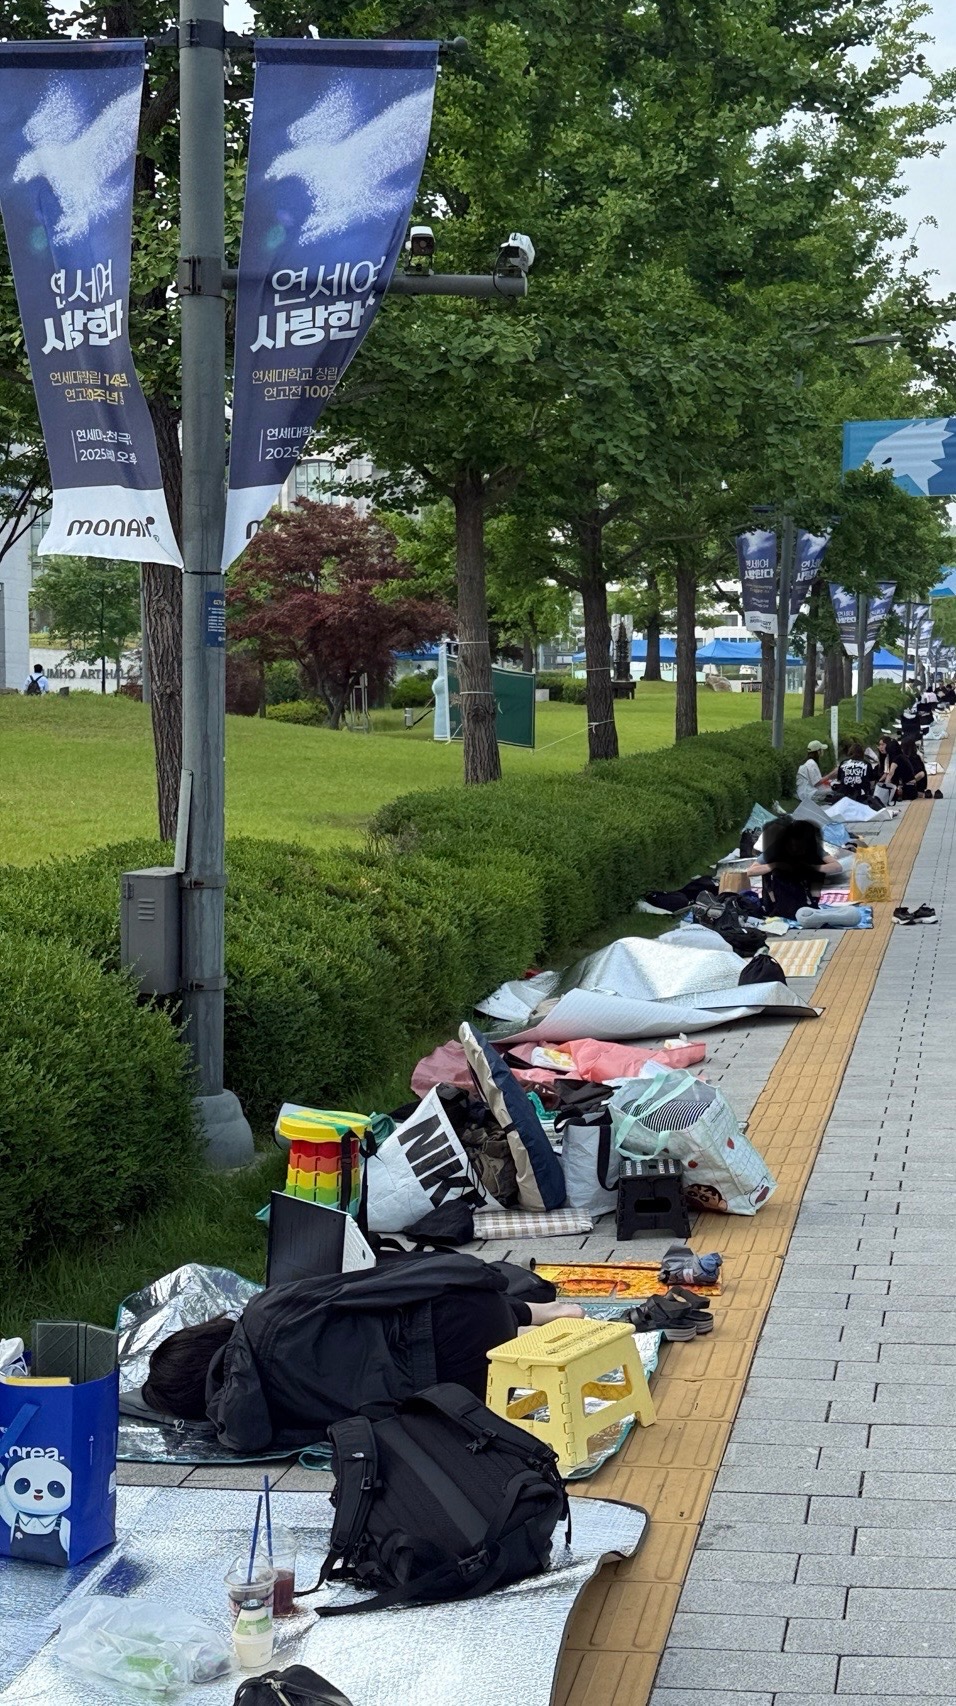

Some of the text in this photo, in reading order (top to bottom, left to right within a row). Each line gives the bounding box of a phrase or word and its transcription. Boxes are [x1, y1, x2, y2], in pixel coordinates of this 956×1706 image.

[249, 290, 376, 353] 사랑한
[252, 366, 338, 384] 연세대학교 창립
[264, 385, 302, 401] 연고전
[265, 446, 300, 460] 2025
[81, 668, 103, 680] ART
